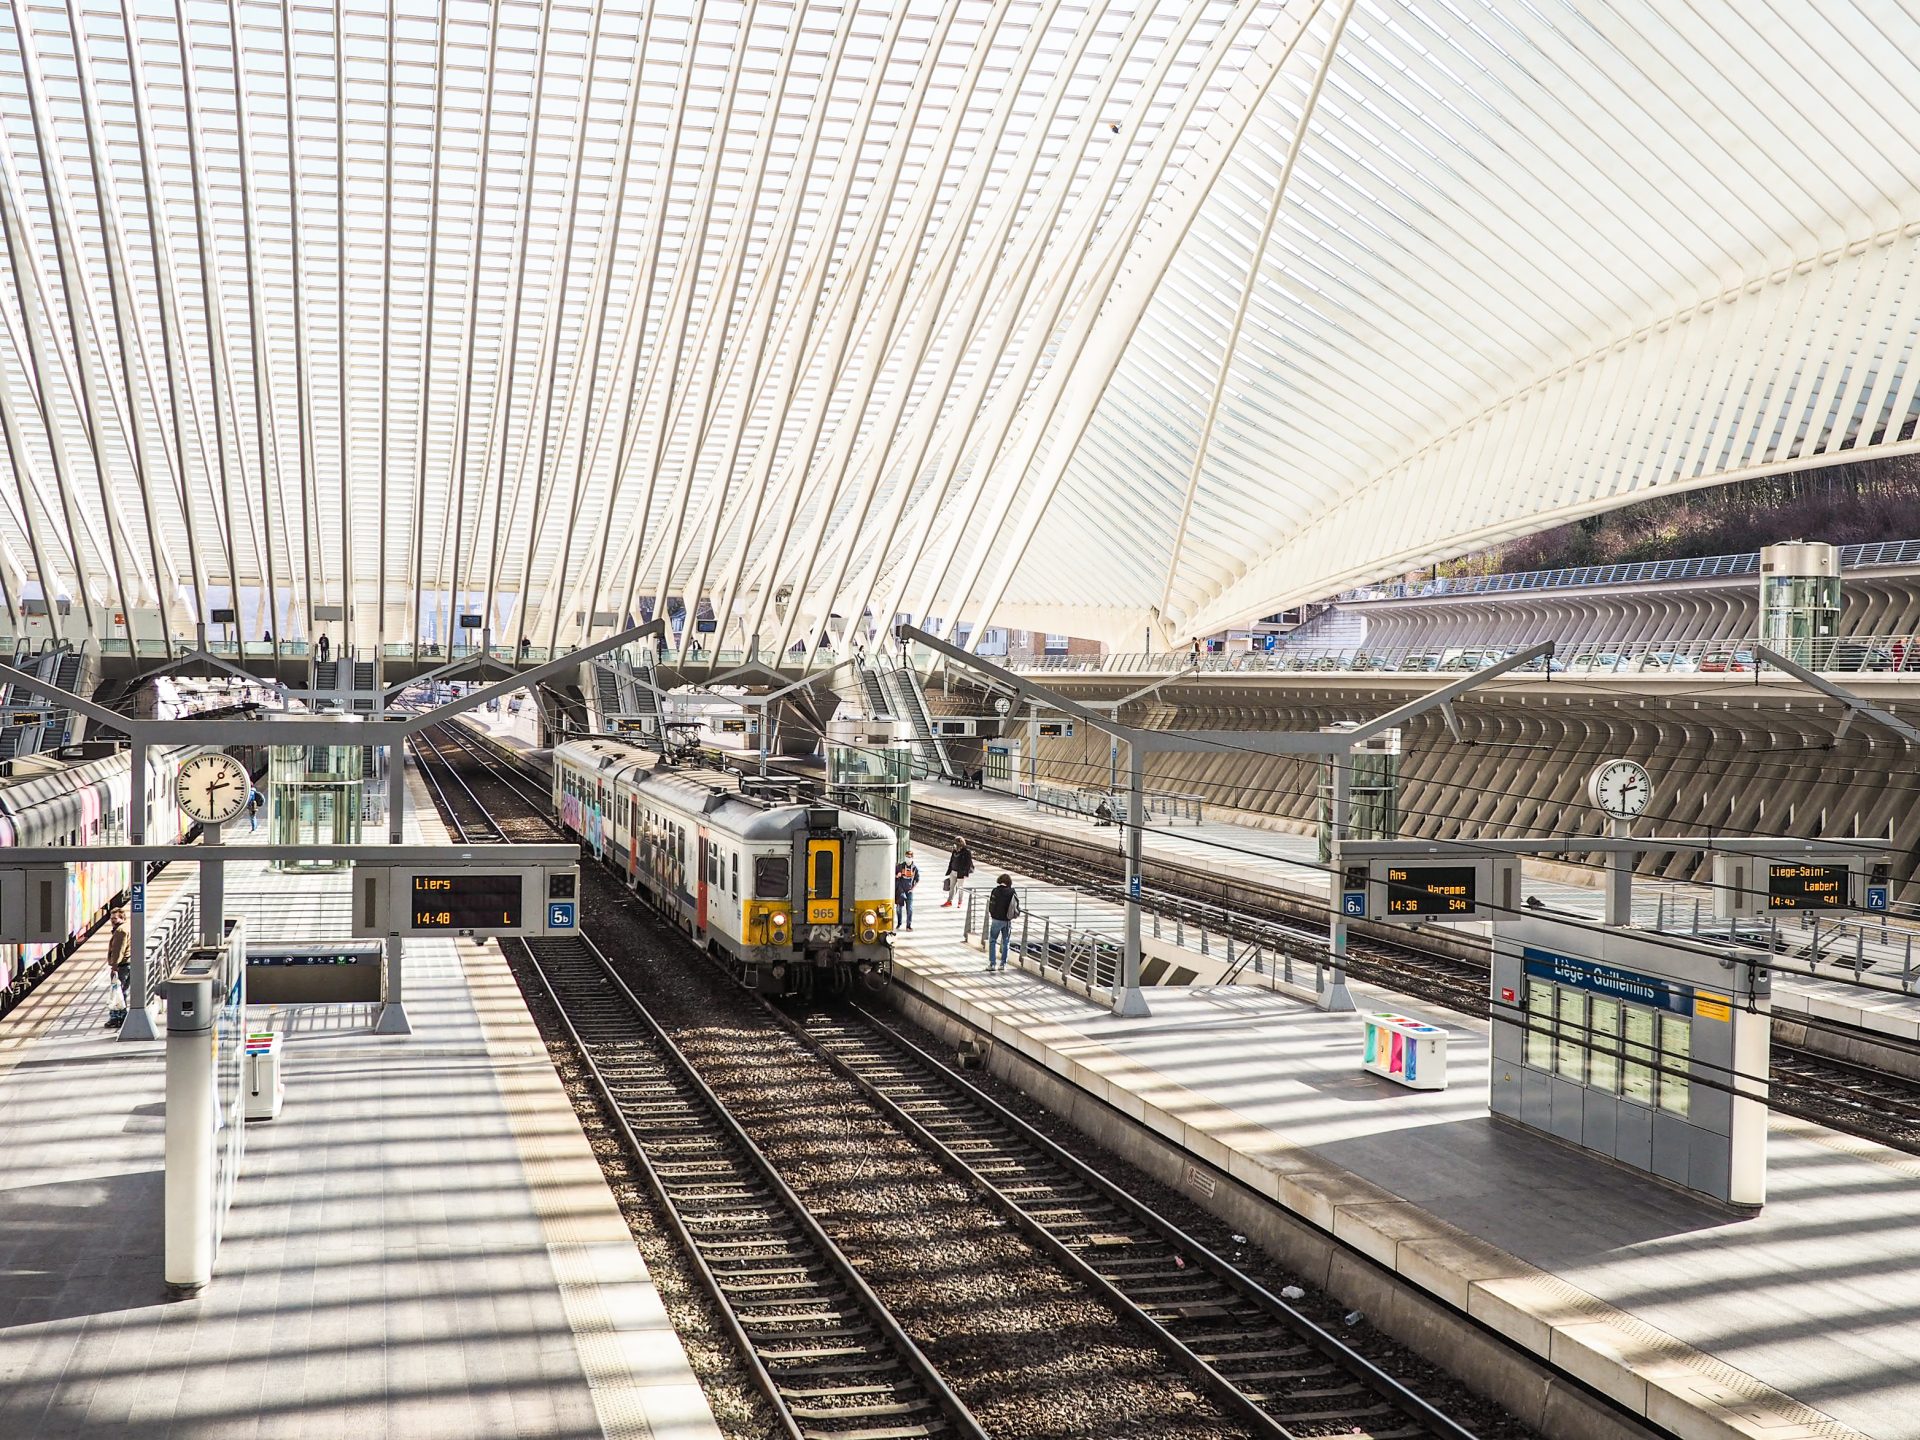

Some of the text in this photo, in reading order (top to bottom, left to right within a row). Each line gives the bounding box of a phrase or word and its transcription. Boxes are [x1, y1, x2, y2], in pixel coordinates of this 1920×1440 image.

[1266, 635, 1274, 647] P
[1389, 869, 1407, 881] Ans
[415, 877, 451, 890] Liers
[1804, 881, 1839, 892] Lambert
[1347, 900, 1361, 913] 6b
[1390, 899, 1466, 911] 14:36 S44
[1871, 895, 1883, 906] 7b
[416, 911, 511, 924] 14:48 L
[553, 910, 569, 924] 5b
[812, 907, 835, 919] 965
[809, 924, 845, 944] PSK
[1554, 957, 1584, 983] Liège
[1593, 967, 1655, 999] Guillemins
